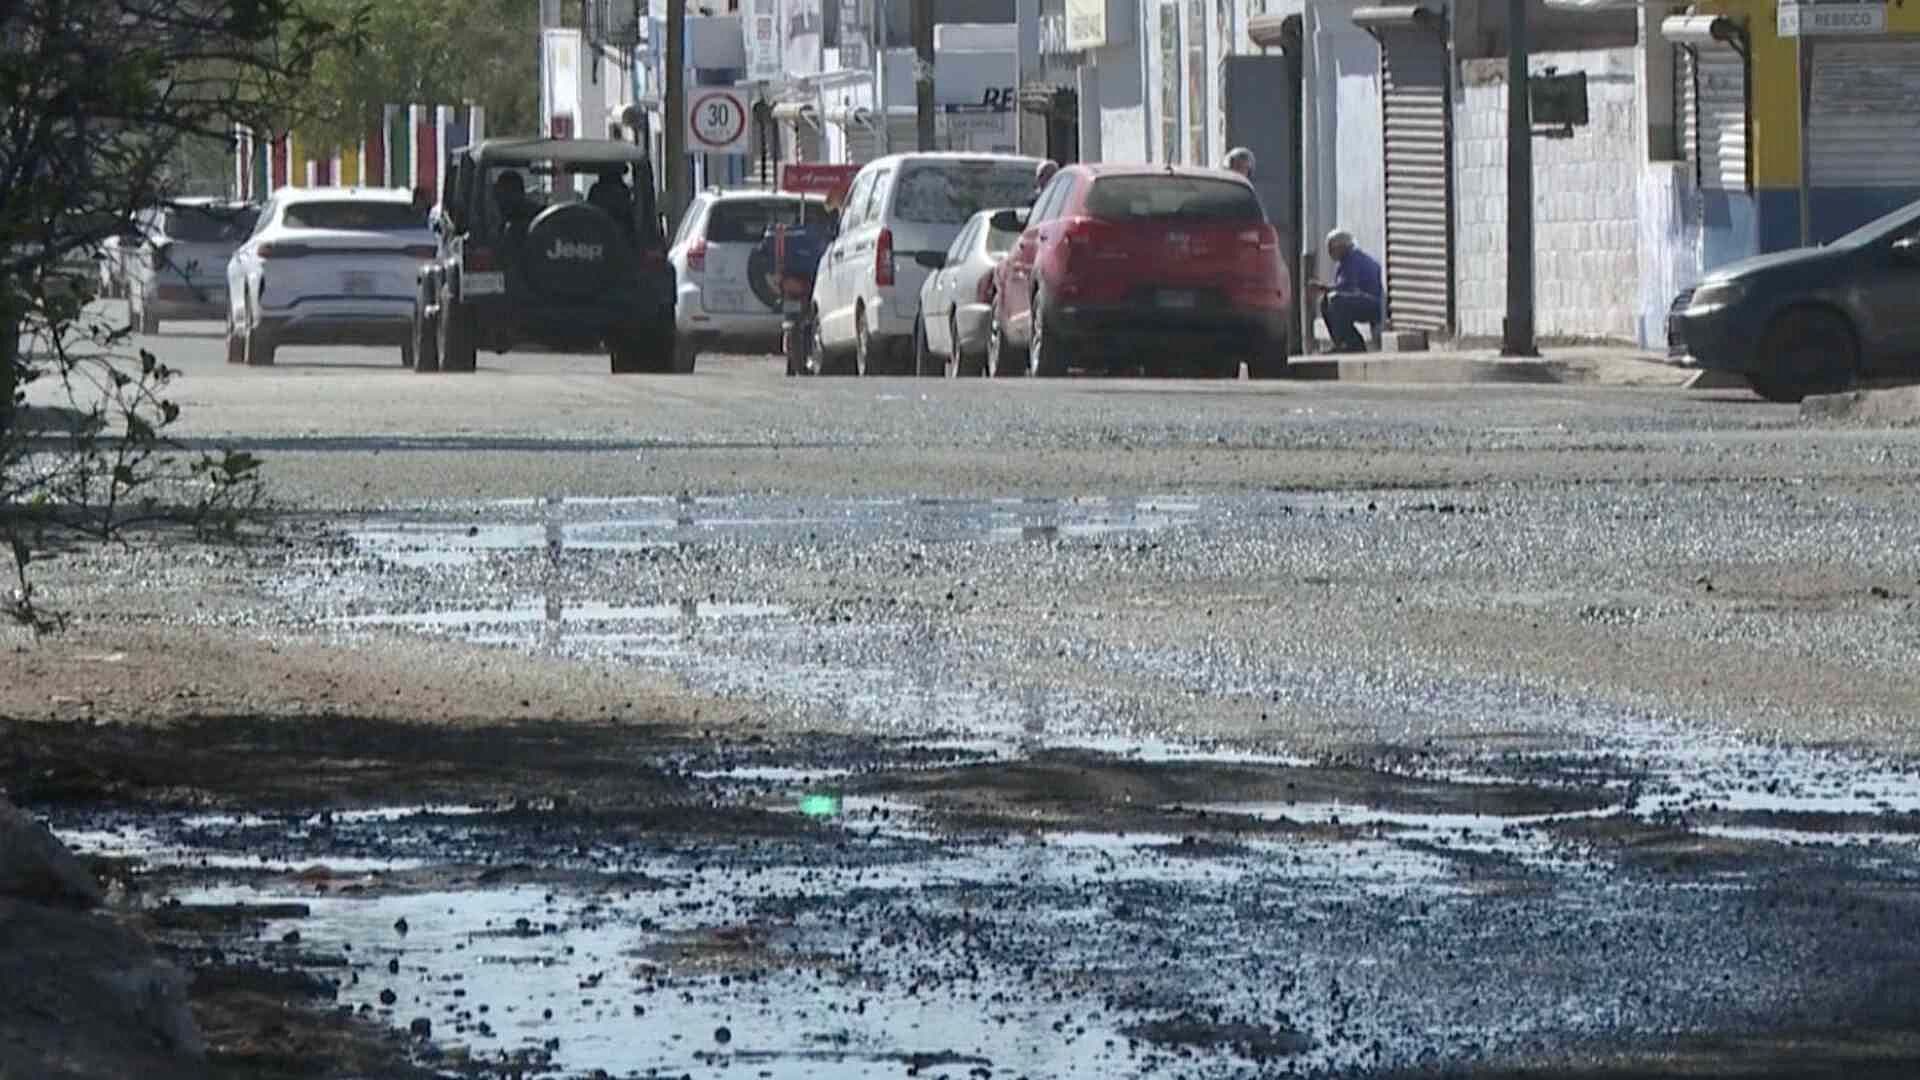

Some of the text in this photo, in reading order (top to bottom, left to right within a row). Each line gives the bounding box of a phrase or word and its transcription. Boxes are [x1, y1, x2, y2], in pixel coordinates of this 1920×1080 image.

[982, 86, 1017, 113] RE
[707, 103, 728, 127] 30
[546, 239, 603, 261] Jeep
